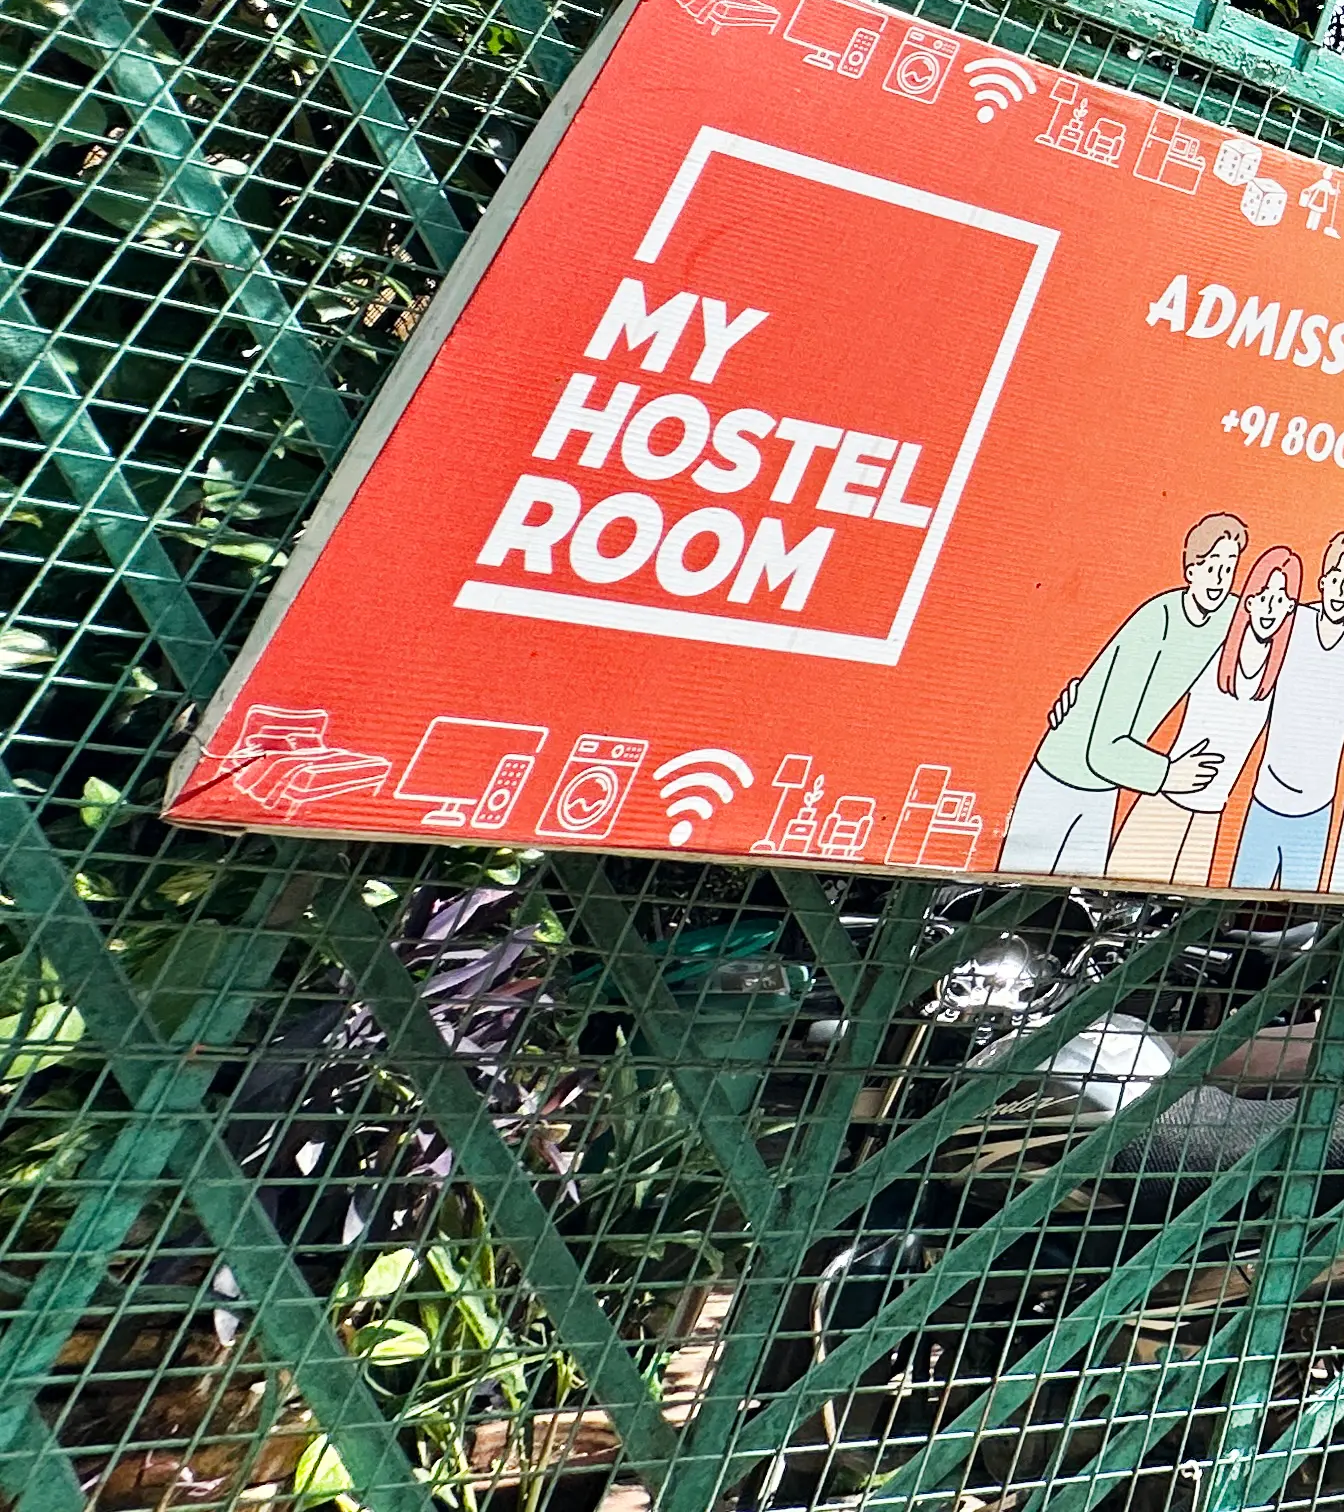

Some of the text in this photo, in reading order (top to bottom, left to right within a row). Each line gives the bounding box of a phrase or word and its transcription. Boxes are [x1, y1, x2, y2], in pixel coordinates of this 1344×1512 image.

[583, 277, 771, 384] MY
[531, 373, 933, 528] HOSTEL
[1221, 406, 1279, 447] +91
[475, 474, 836, 612] ROOM
